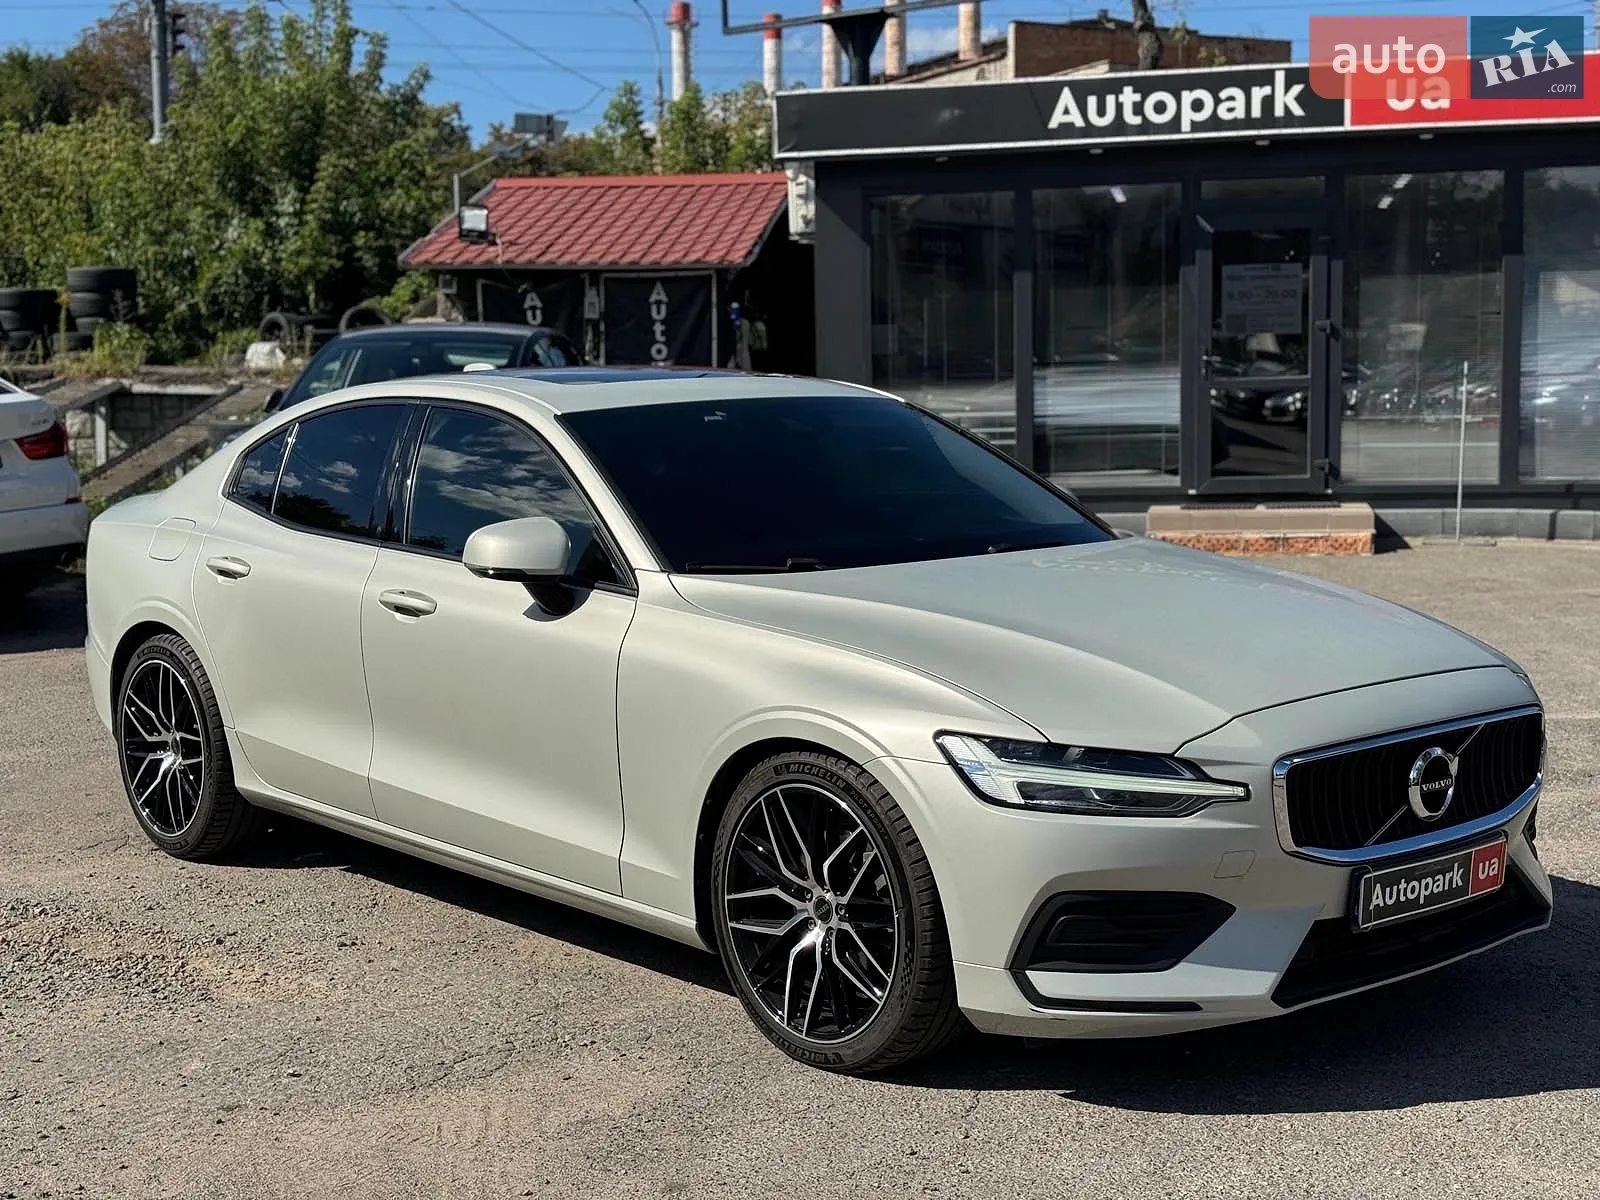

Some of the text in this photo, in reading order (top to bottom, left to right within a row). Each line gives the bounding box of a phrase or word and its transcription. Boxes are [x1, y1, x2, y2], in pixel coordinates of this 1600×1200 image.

[1047, 70, 1451, 132] Autopark ua
[789, 763, 847, 788] MICHELIN
[1421, 778, 1452, 792] VOLVO
[1369, 856, 1499, 910] Autopark ua
